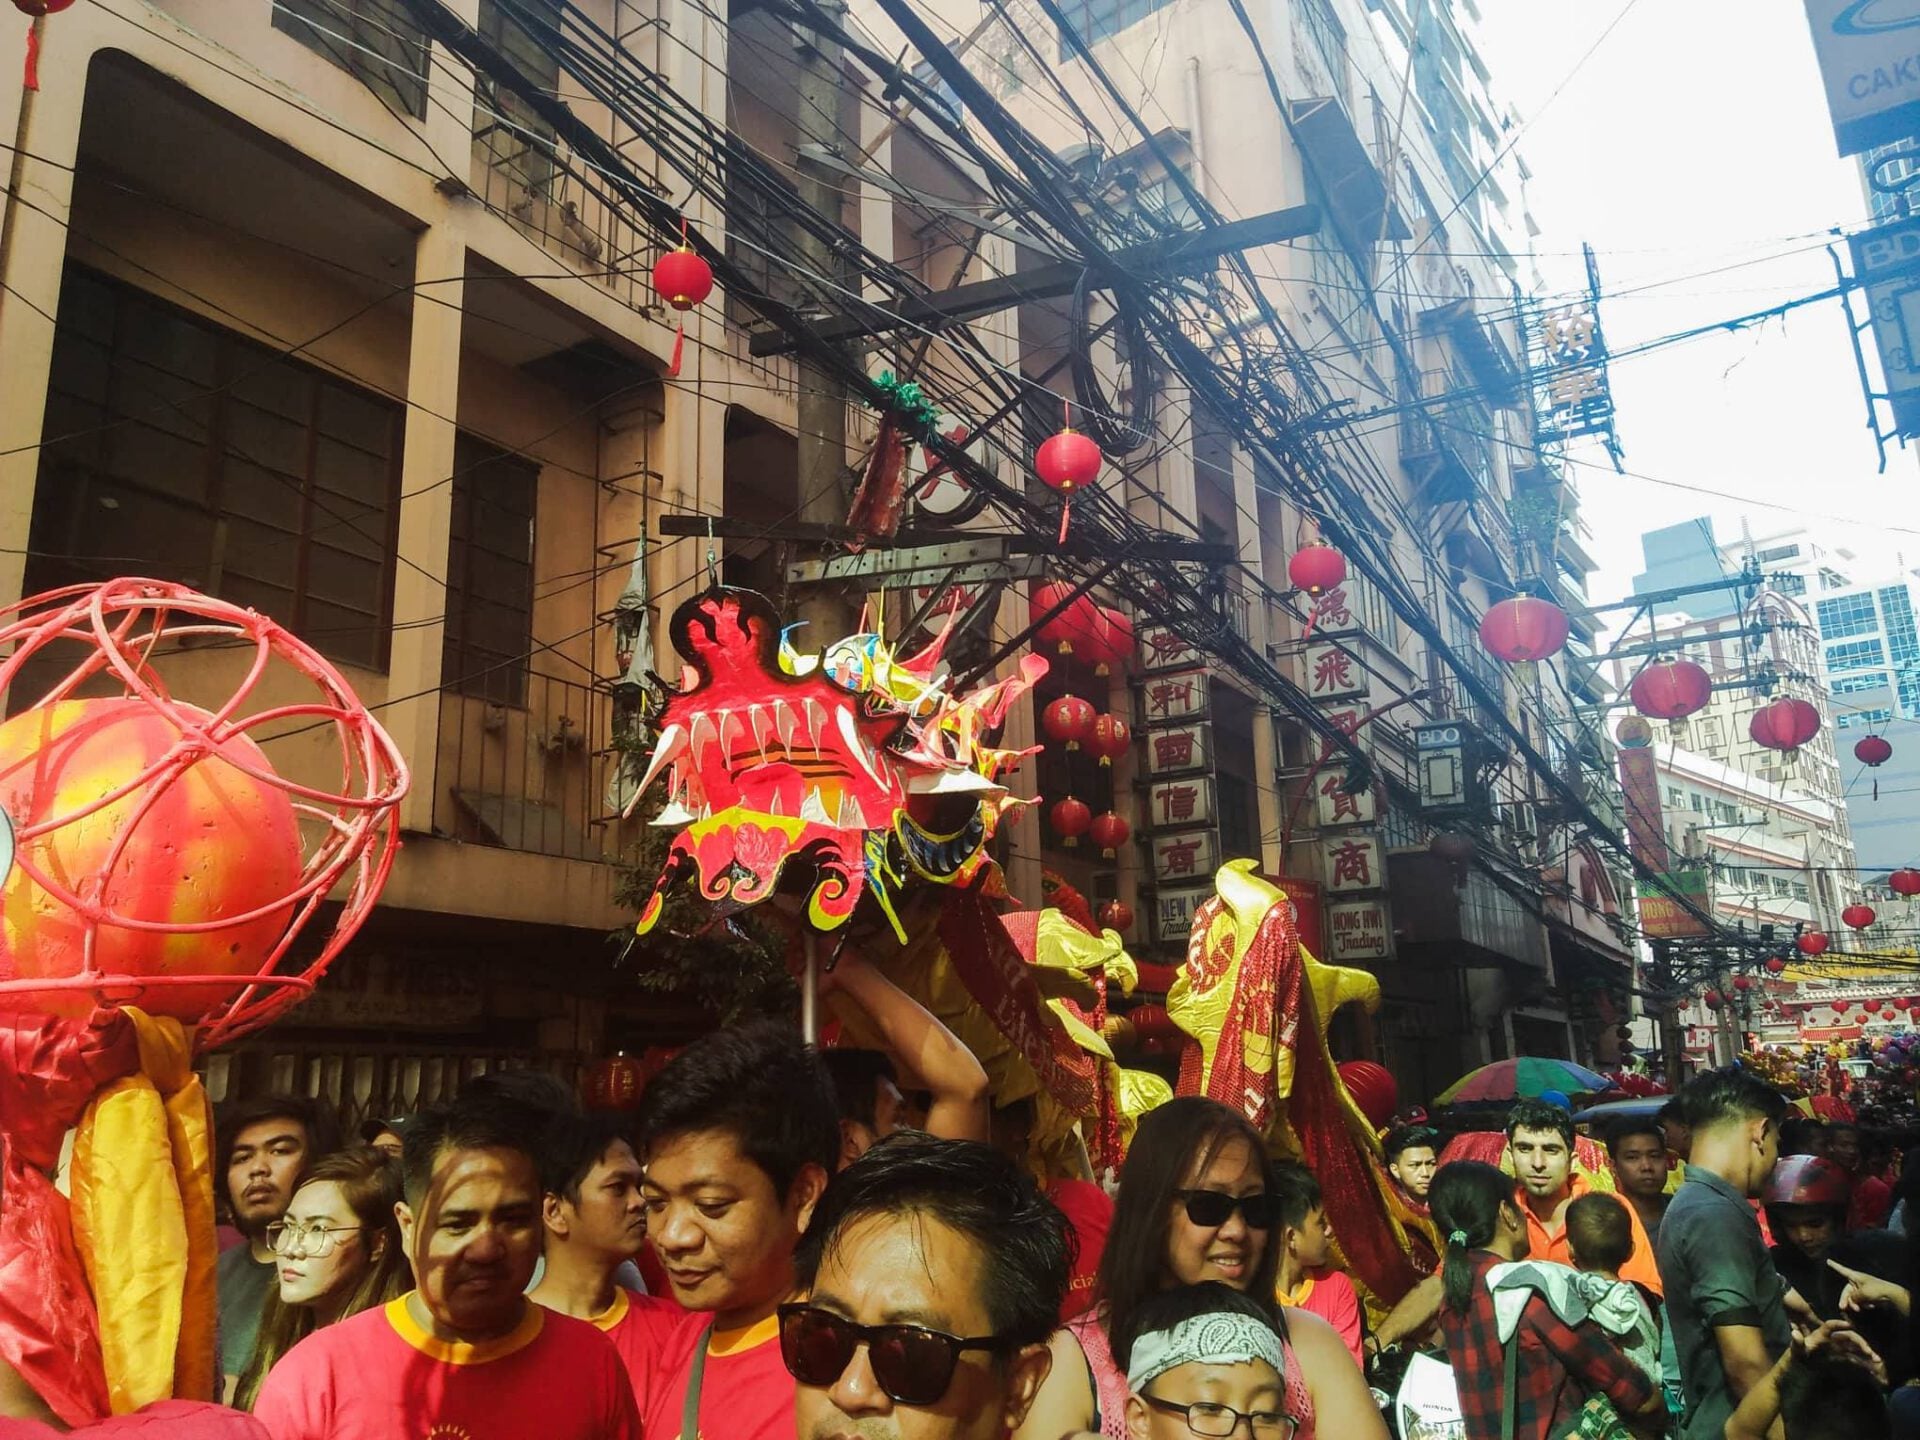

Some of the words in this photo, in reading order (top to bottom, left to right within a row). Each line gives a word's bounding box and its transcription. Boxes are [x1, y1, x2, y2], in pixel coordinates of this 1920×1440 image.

[1418, 727, 1460, 745] BDO
[1161, 896, 1187, 918] NEW
[1333, 911, 1360, 930] HONG
[1335, 931, 1384, 956] Trading
